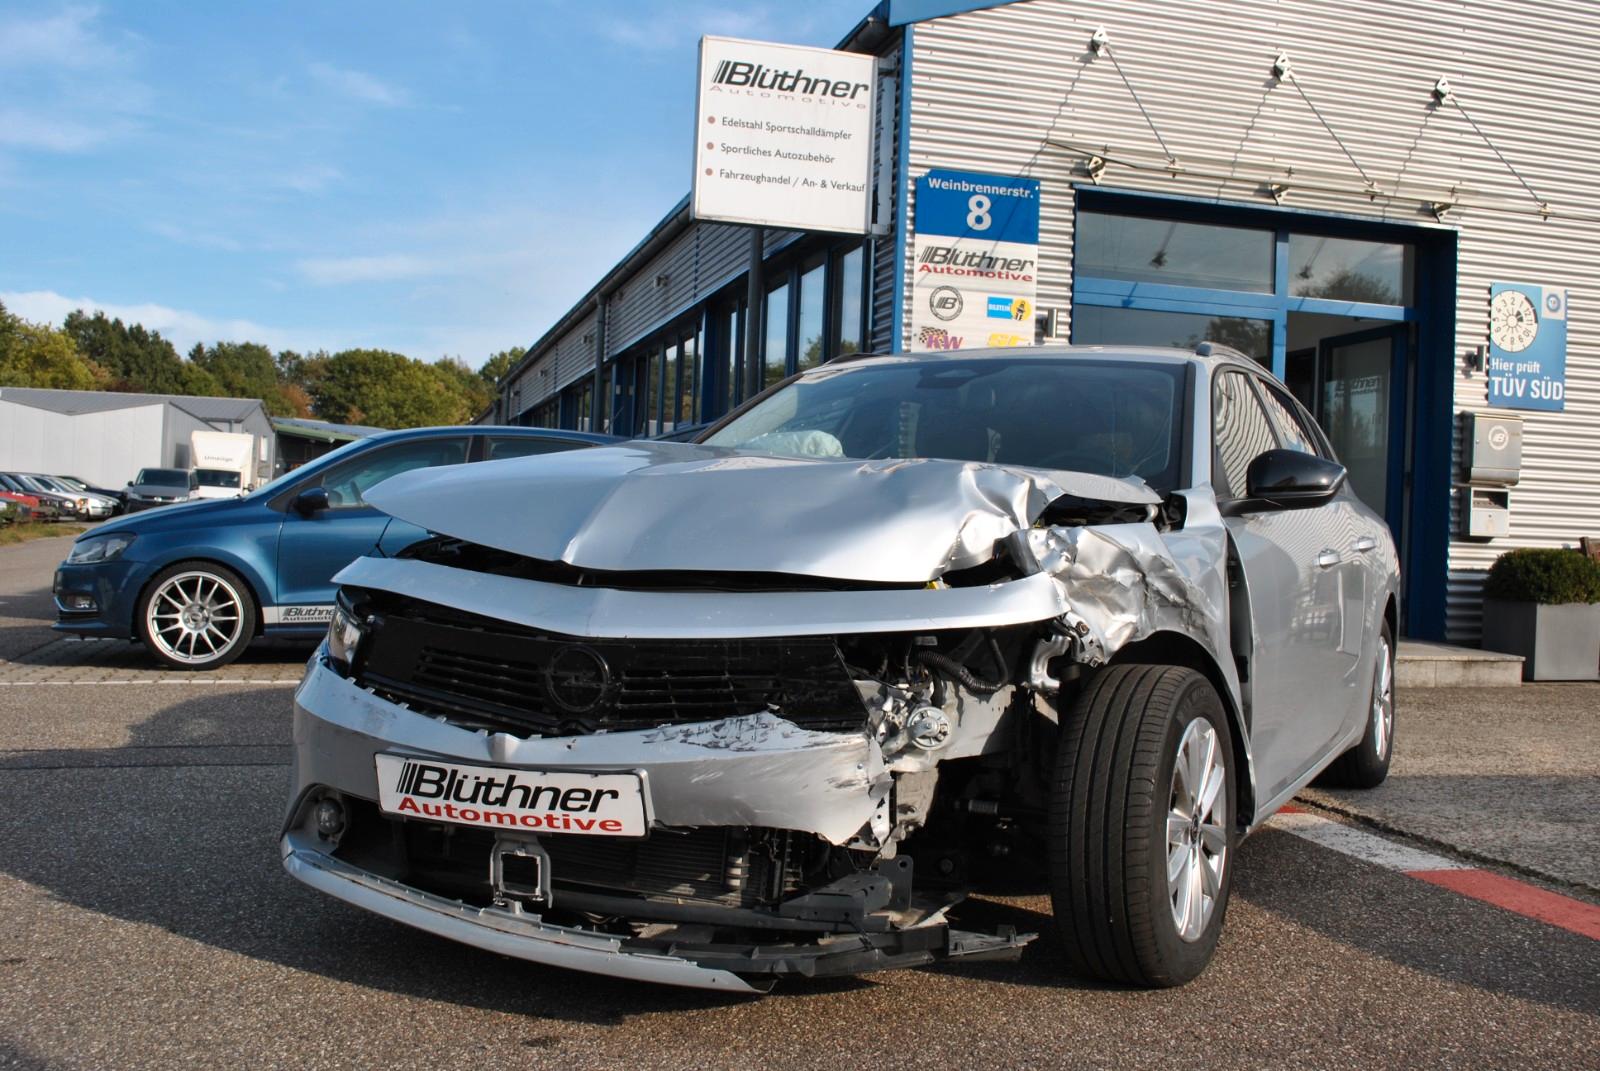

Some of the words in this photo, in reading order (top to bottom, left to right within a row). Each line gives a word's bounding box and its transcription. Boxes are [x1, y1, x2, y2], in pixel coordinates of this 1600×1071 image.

[712, 60, 869, 99] Blüthner
[710, 85, 867, 109] Automotive
[722, 117, 763, 130] Edelstahl
[766, 122, 852, 140] Sportschalldämpfer
[721, 143, 772, 157] Sportliches
[774, 149, 834, 163] Autozubehör
[719, 169, 791, 184] Fahrzeughandel
[802, 178, 818, 187] An-
[821, 180, 827, 188] &
[830, 180, 865, 192] Verkauf
[928, 178, 1034, 198] Weinbrennerstr.
[966, 195, 992, 231] 8
[920, 246, 1034, 272] Blüthner
[918, 264, 1033, 282] Automotive
[1491, 358, 1514, 370] Hier
[1516, 361, 1540, 374] prüft
[1491, 373, 1526, 397] TÜV
[1530, 375, 1564, 400] SÜD
[284, 607, 335, 616] Blüthne
[398, 761, 619, 812] Blüthner
[398, 797, 623, 832] Automotive
